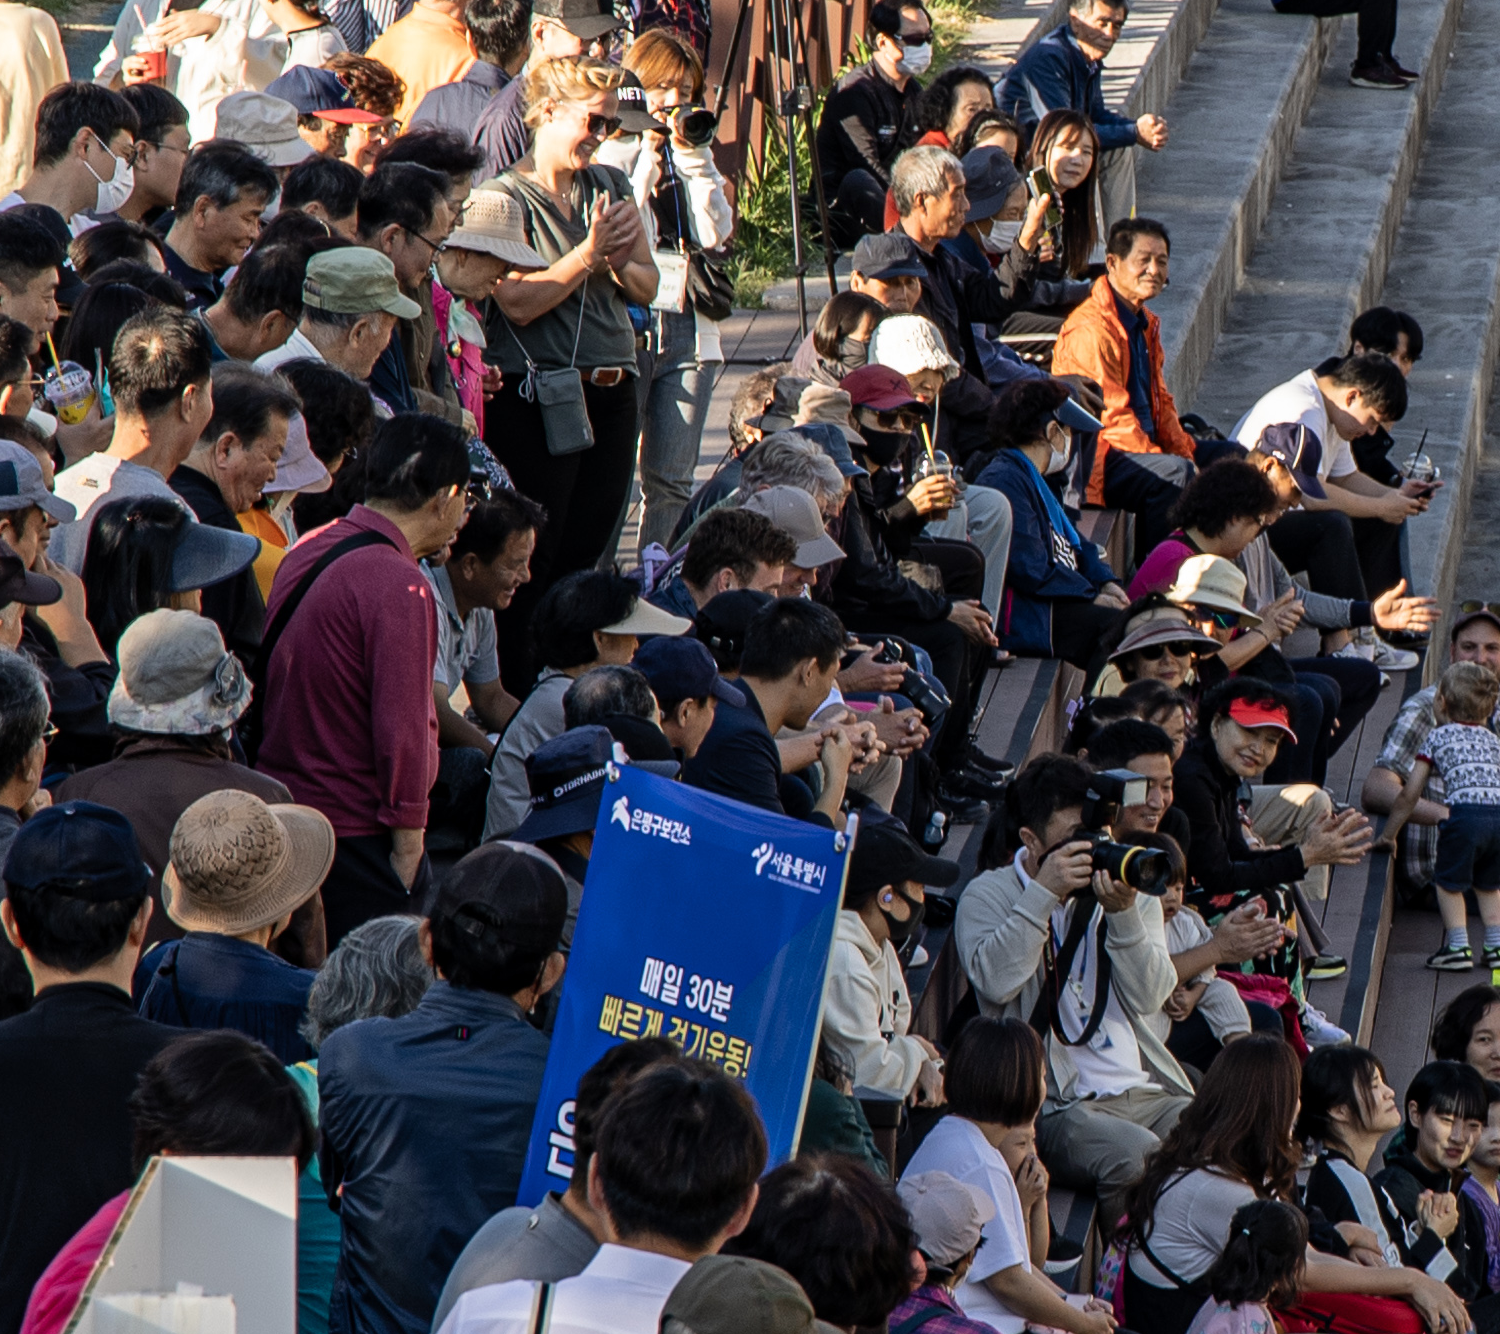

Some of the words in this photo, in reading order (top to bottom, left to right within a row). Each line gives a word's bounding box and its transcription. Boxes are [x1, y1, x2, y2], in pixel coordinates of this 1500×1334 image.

[631, 808, 692, 846] 은평구보건소
[770, 851, 827, 887] 서울특별시
[639, 956, 684, 1007] 매일
[685, 974, 733, 1023] 30분
[598, 994, 664, 1041] 빠르게
